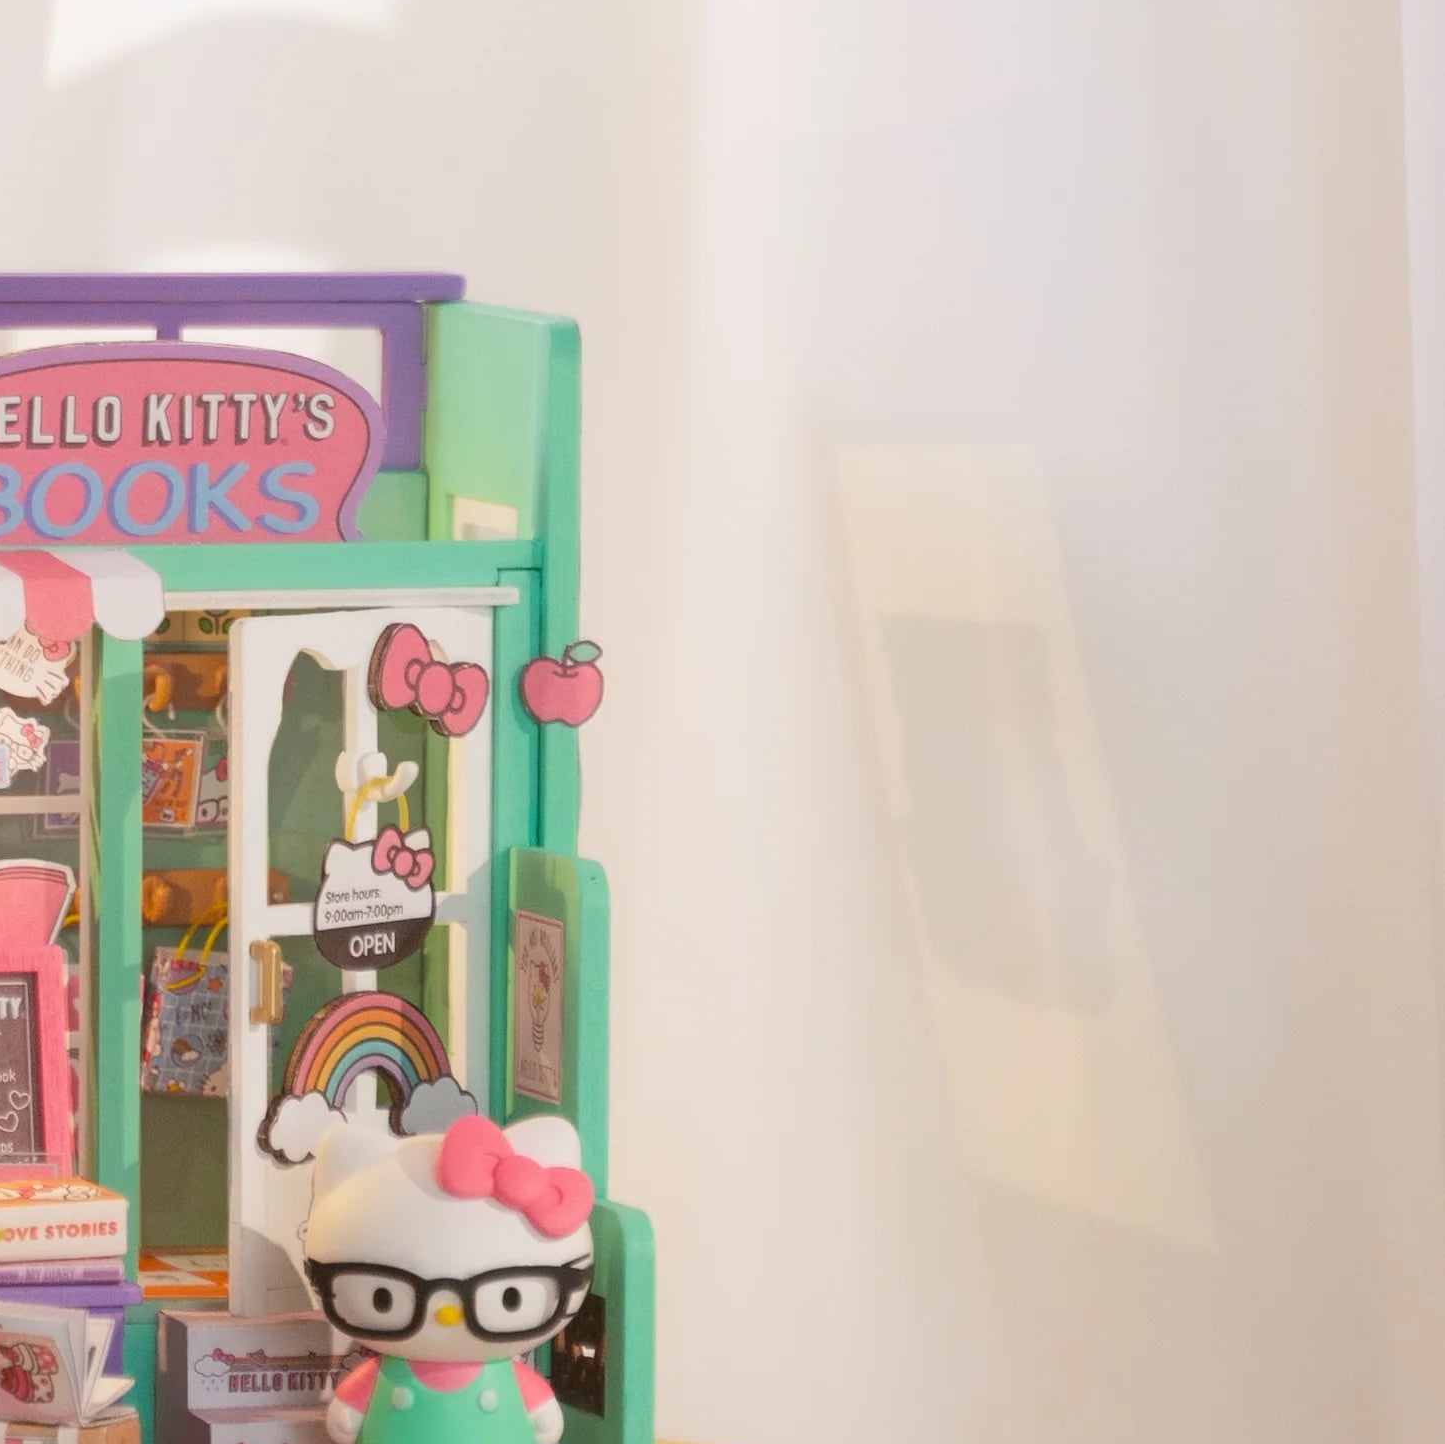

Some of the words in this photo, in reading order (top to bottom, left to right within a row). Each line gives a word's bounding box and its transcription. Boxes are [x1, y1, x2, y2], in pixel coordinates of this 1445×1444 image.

[142, 392, 336, 446] KITTY'S
[324, 891, 351, 905] Store
[352, 888, 383, 902] hours:
[349, 932, 396, 958] OPEN
[5, 1226, 38, 1243] OVE
[44, 1221, 118, 1240] STORIES
[228, 1372, 283, 1393] HELLO
